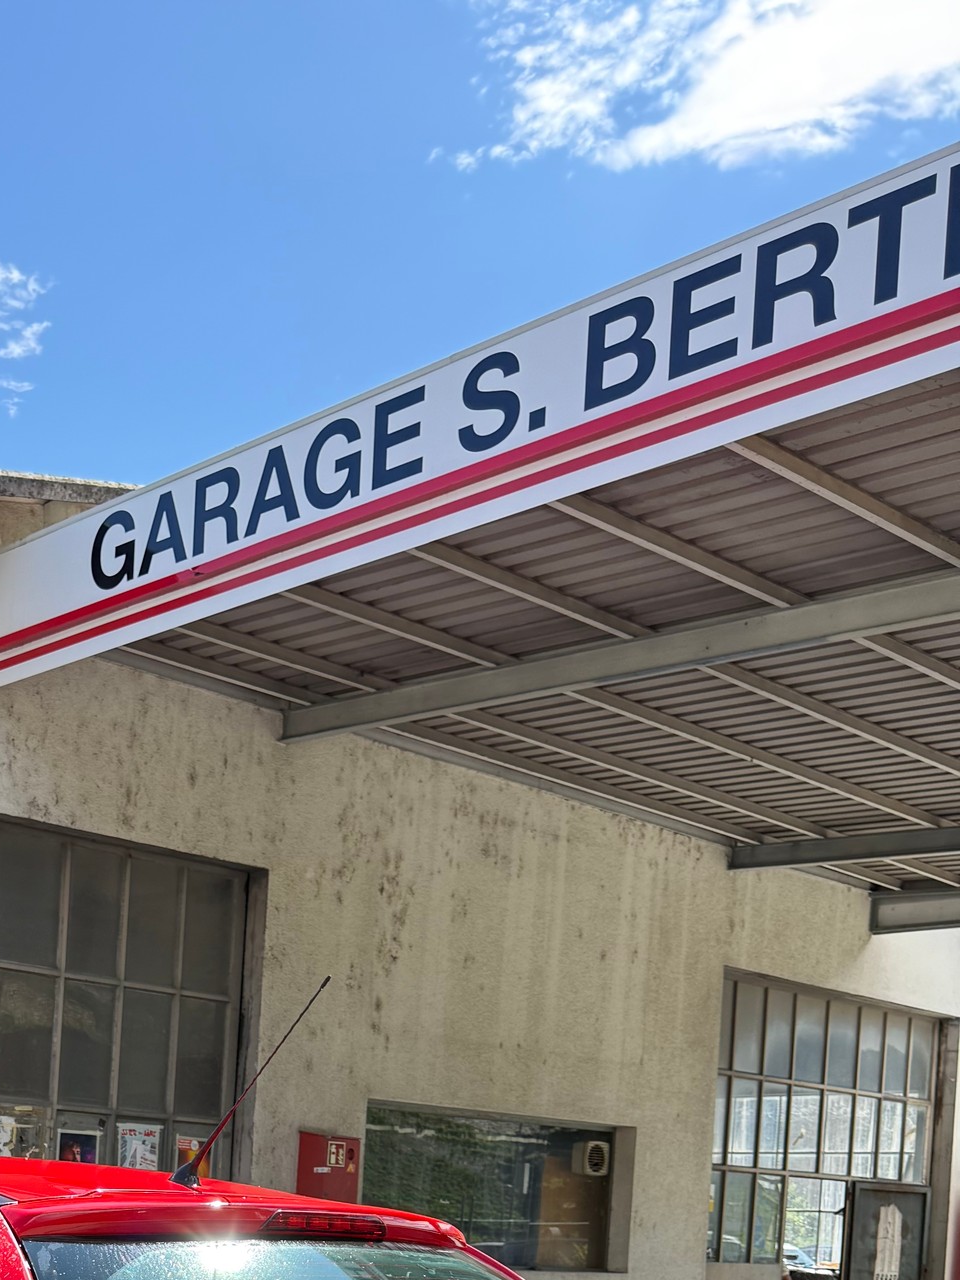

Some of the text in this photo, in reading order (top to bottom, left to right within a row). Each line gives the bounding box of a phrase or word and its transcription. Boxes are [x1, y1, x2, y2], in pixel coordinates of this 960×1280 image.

[91, 163, 960, 590] GARAGE S. BERT
